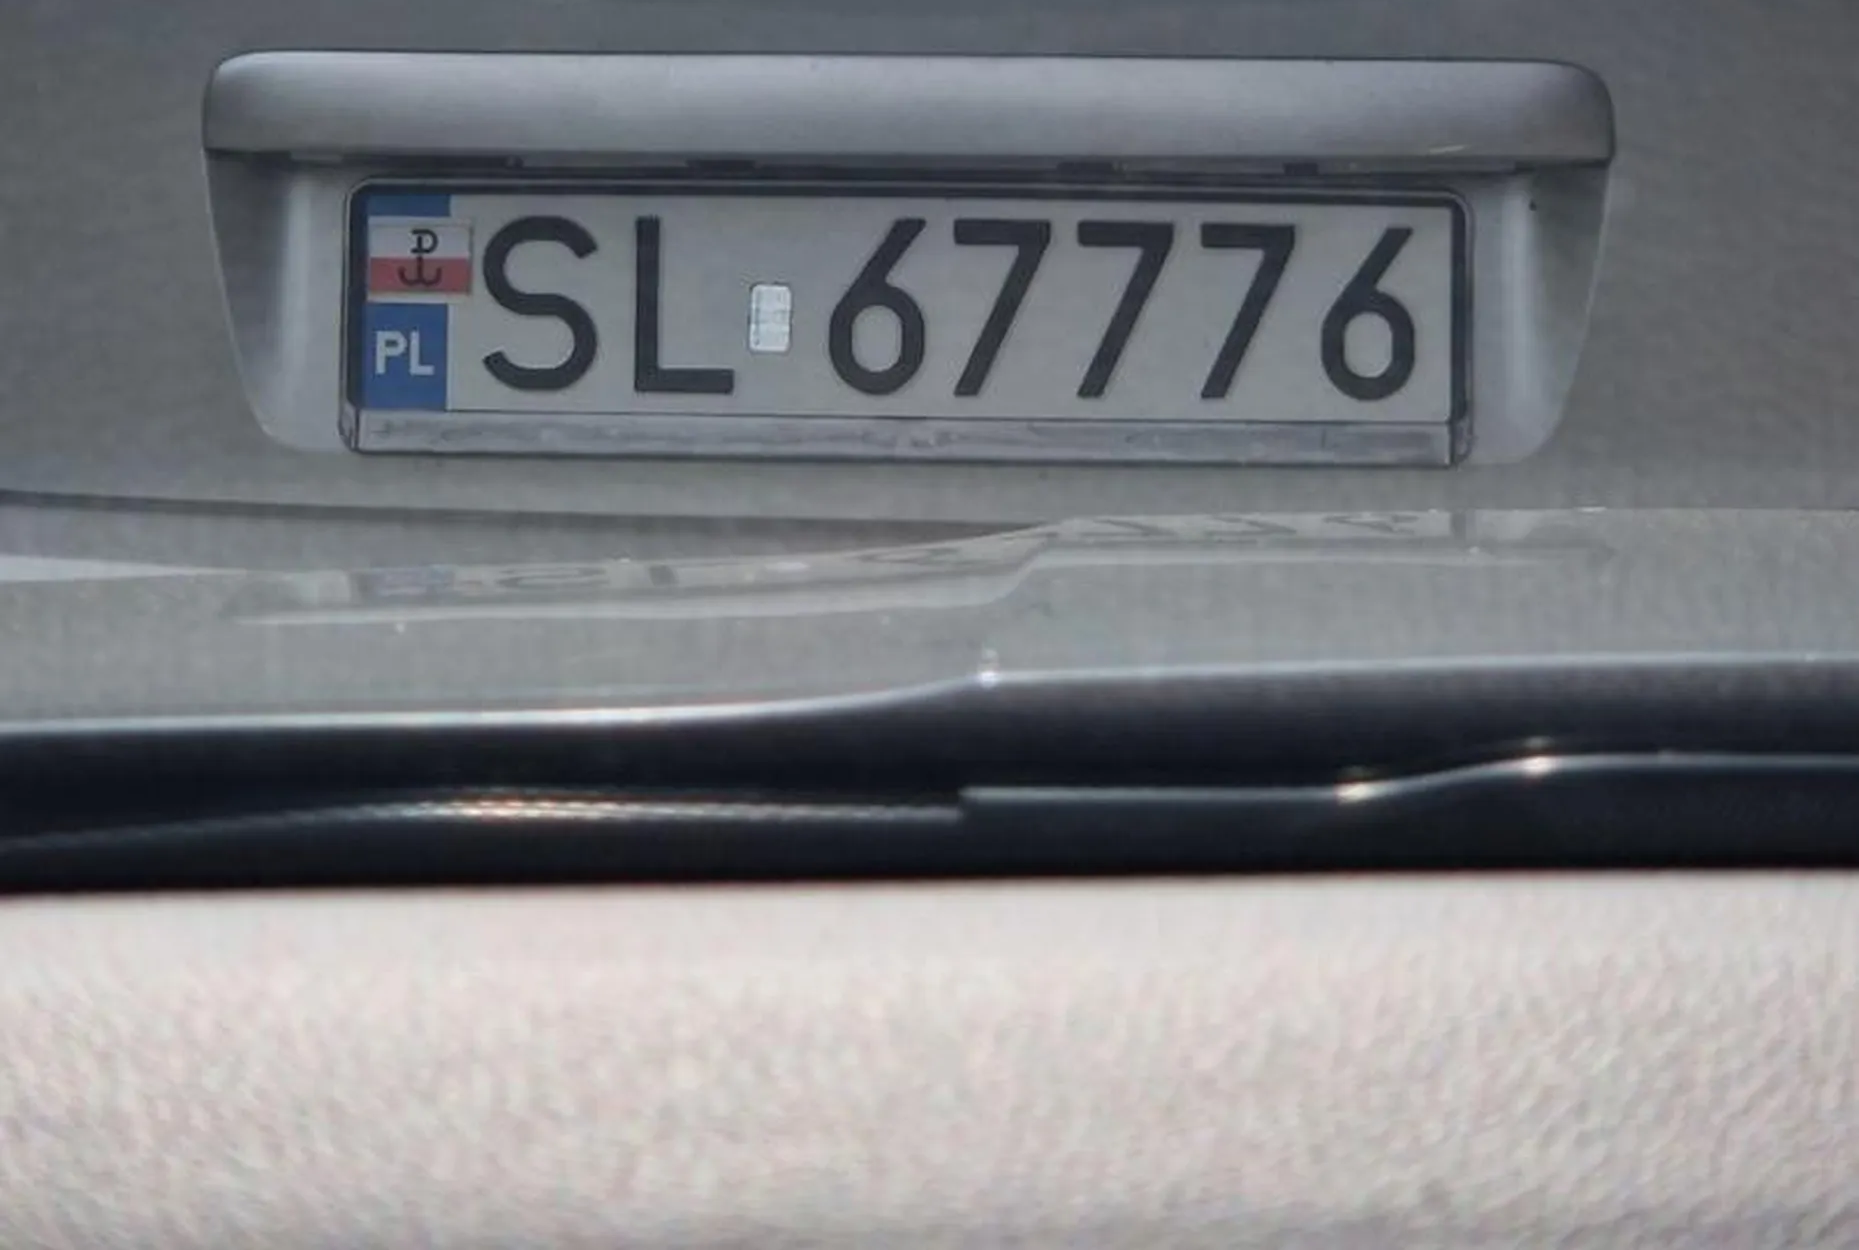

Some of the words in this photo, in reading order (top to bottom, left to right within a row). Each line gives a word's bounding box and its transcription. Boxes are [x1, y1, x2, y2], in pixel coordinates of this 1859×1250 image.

[374, 329, 435, 376] PL
[482, 215, 735, 393] SL
[828, 218, 1416, 402] 67776
